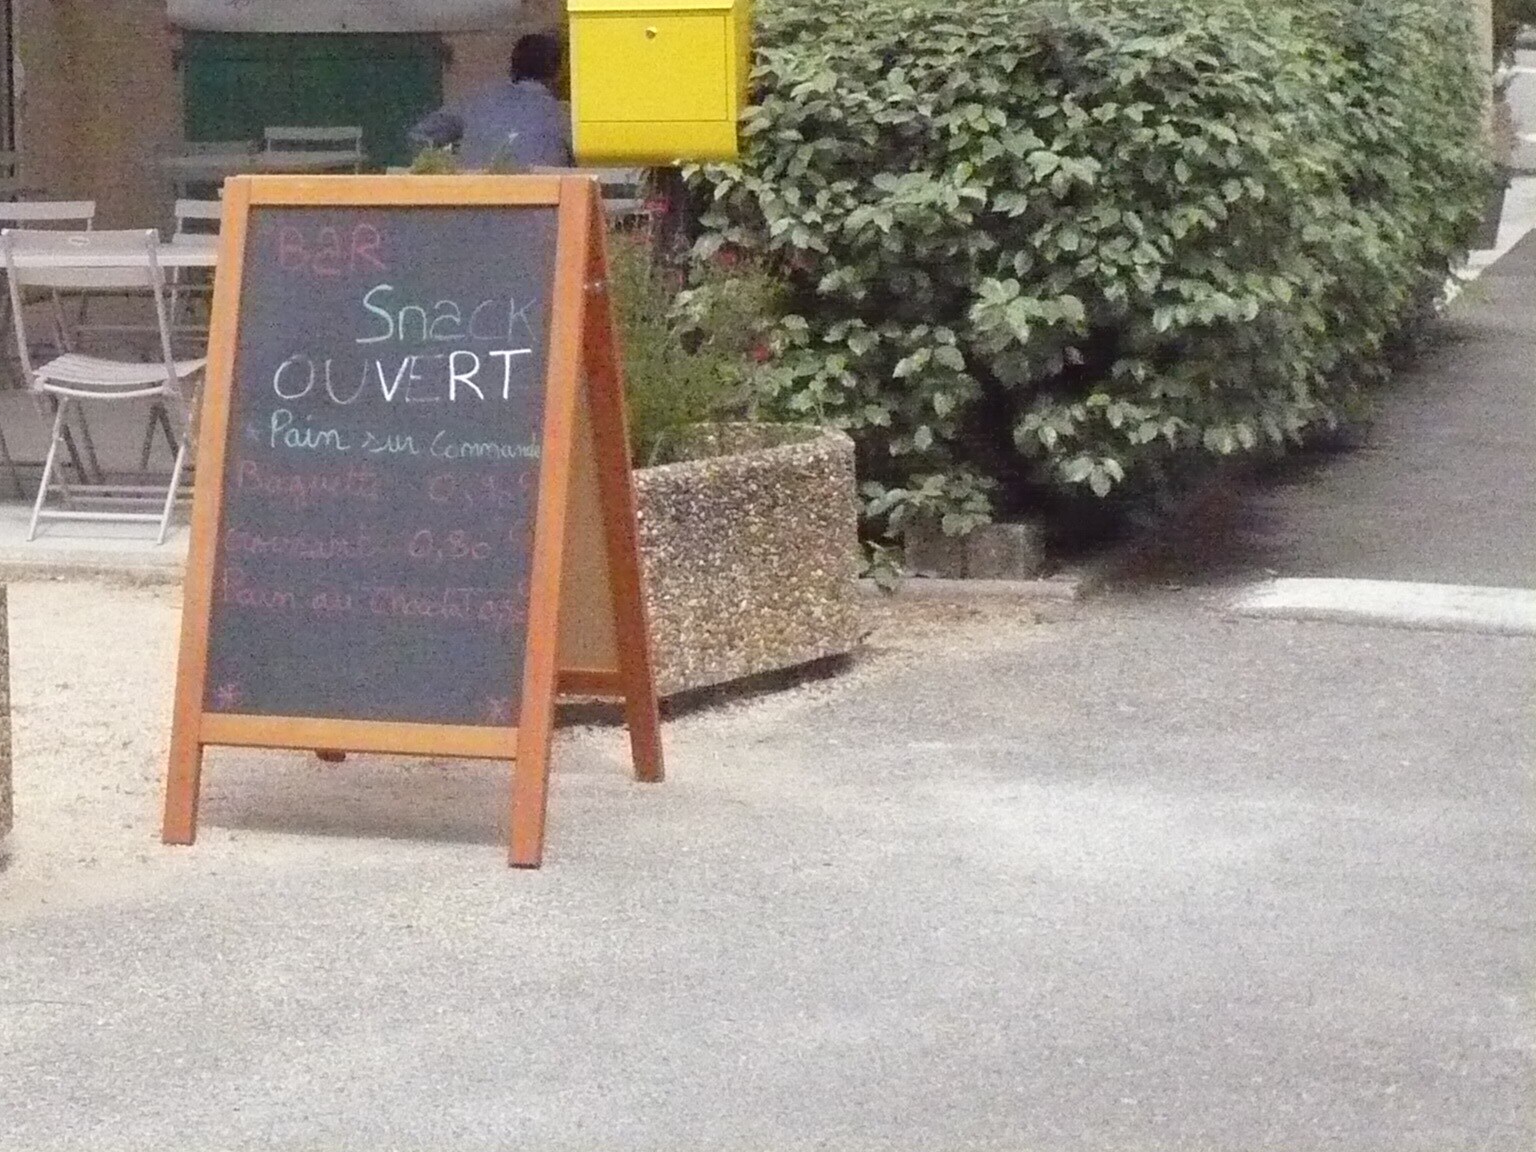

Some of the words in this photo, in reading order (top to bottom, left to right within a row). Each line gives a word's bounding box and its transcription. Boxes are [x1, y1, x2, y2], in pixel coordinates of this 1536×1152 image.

[355, 282, 538, 344] Snack
[272, 347, 533, 406] OUVERT
[269, 408, 350, 451] Pain
[361, 430, 419, 455] sur
